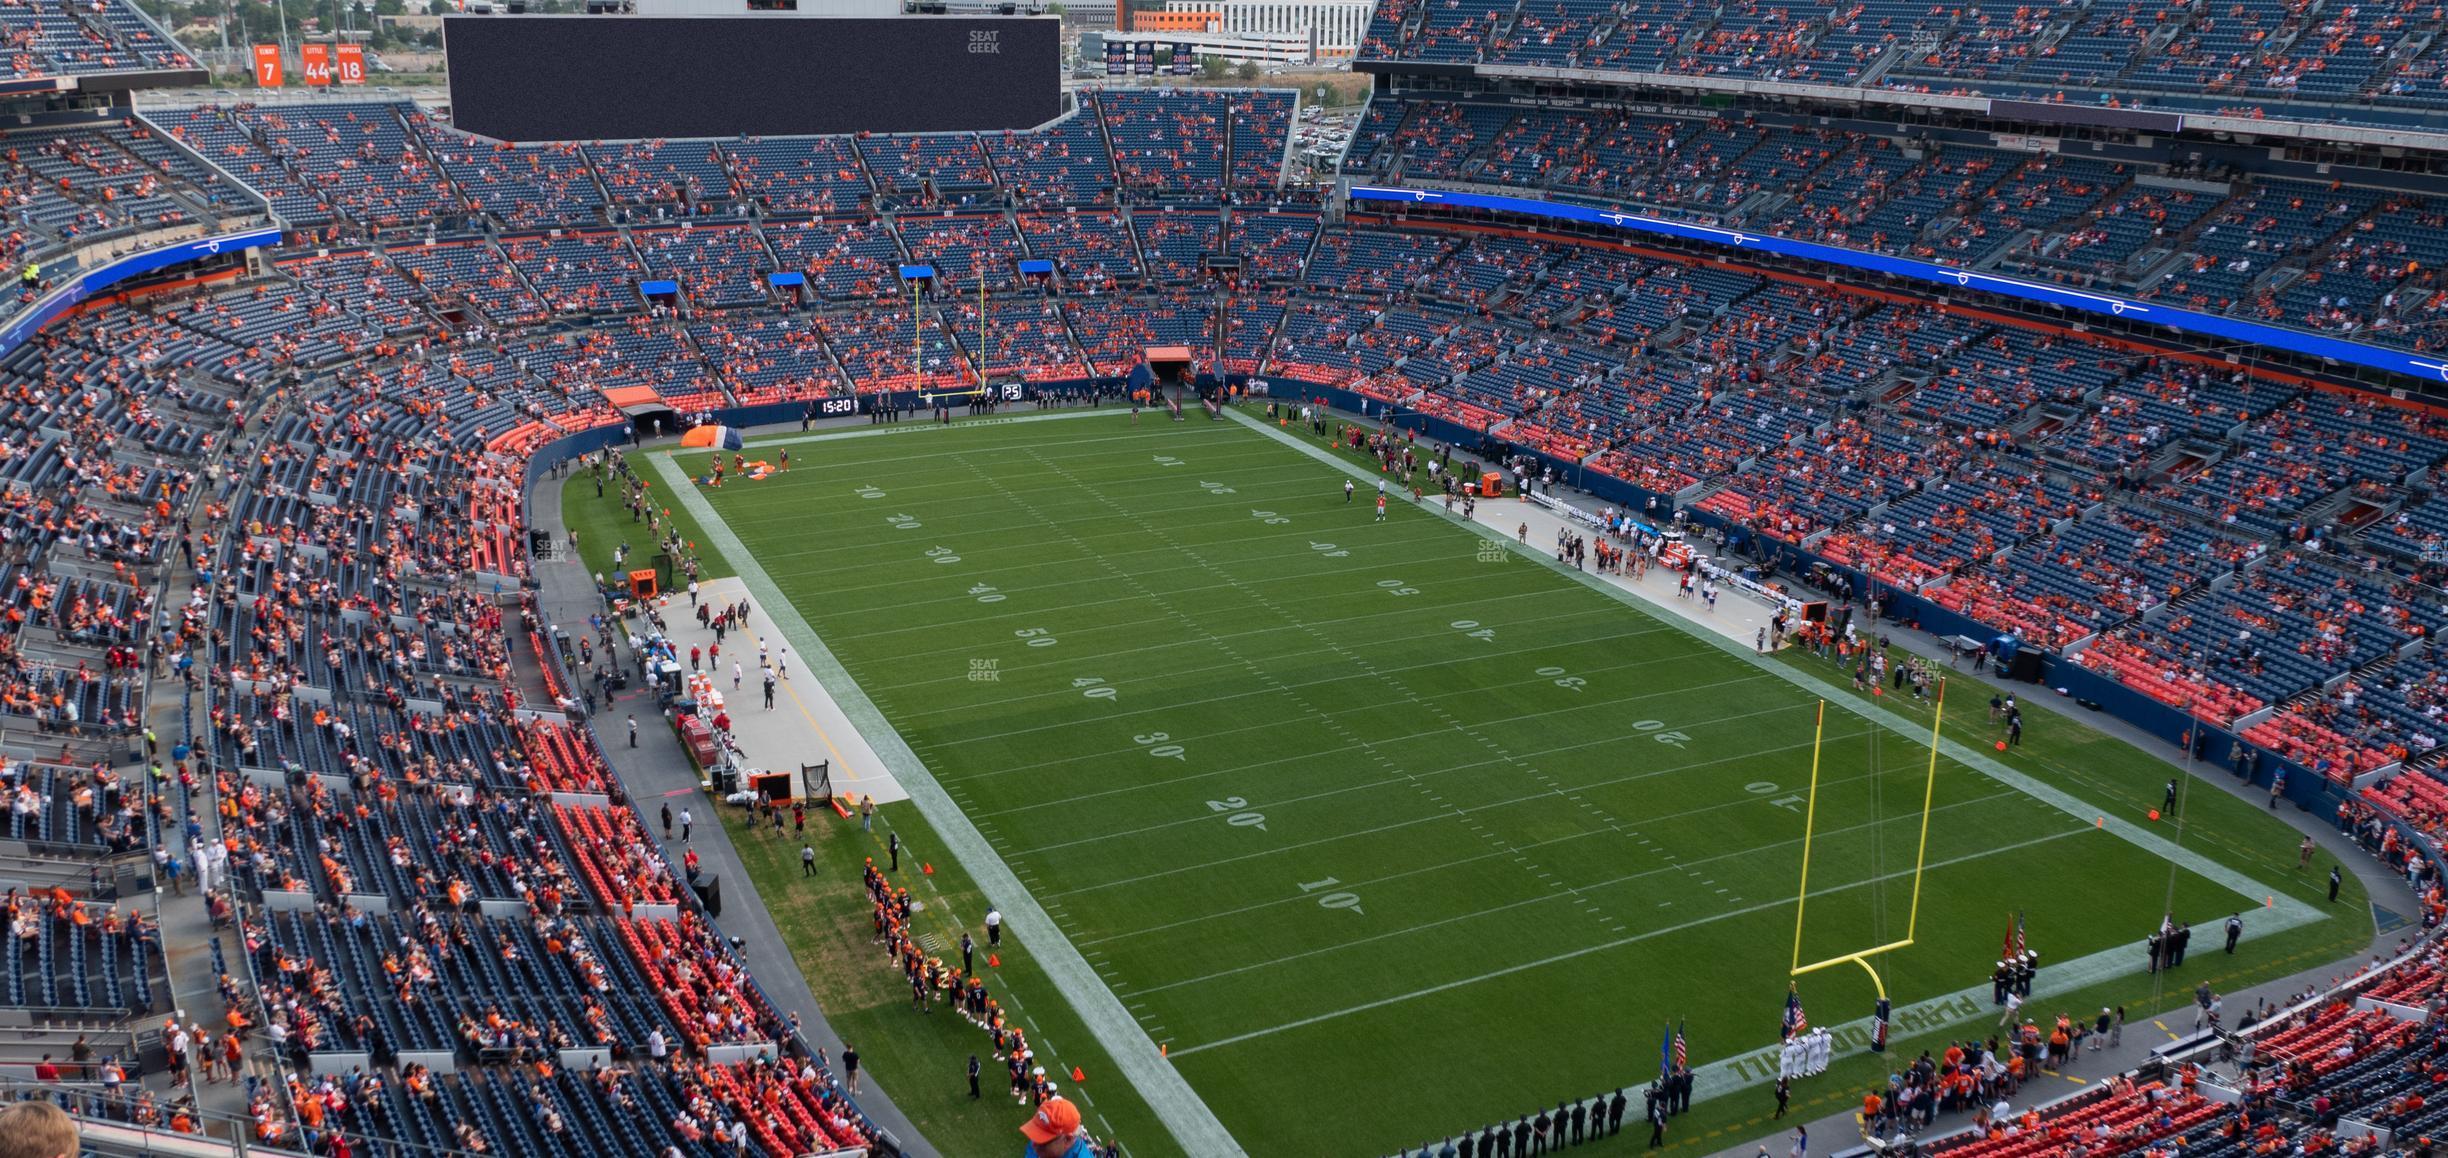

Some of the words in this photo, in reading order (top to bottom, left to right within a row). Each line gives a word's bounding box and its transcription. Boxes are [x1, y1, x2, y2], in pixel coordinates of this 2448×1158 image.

[1108, 54, 1125, 63] 1997
[1136, 54, 1153, 63] 1998
[264, 63, 274, 80] 7
[306, 62, 329, 79] 44
[342, 62, 361, 78] 18
[1005, 386, 1020, 398] 25
[823, 399, 850, 413] 15:20
[1153, 455, 1186, 467] 10
[854, 485, 886, 498] 10
[1200, 481, 1236, 495] 20
[886, 513, 921, 529] 20
[1252, 510, 1291, 525] 30
[925, 546, 961, 564] 30
[1310, 541, 1351, 557] 40
[968, 583, 1007, 603] 40
[1376, 579, 1420, 597] 50
[1015, 627, 1058, 647] 50
[1450, 620, 1495, 642] 40
[1535, 666, 1597, 692] 30
[1072, 677, 1117, 701] 40
[1631, 720, 1692, 749] 20
[1133, 731, 1186, 760] 30
[1744, 781, 1807, 812] 10
[1205, 796, 1267, 831] 20
[1297, 876, 1364, 914] 10
